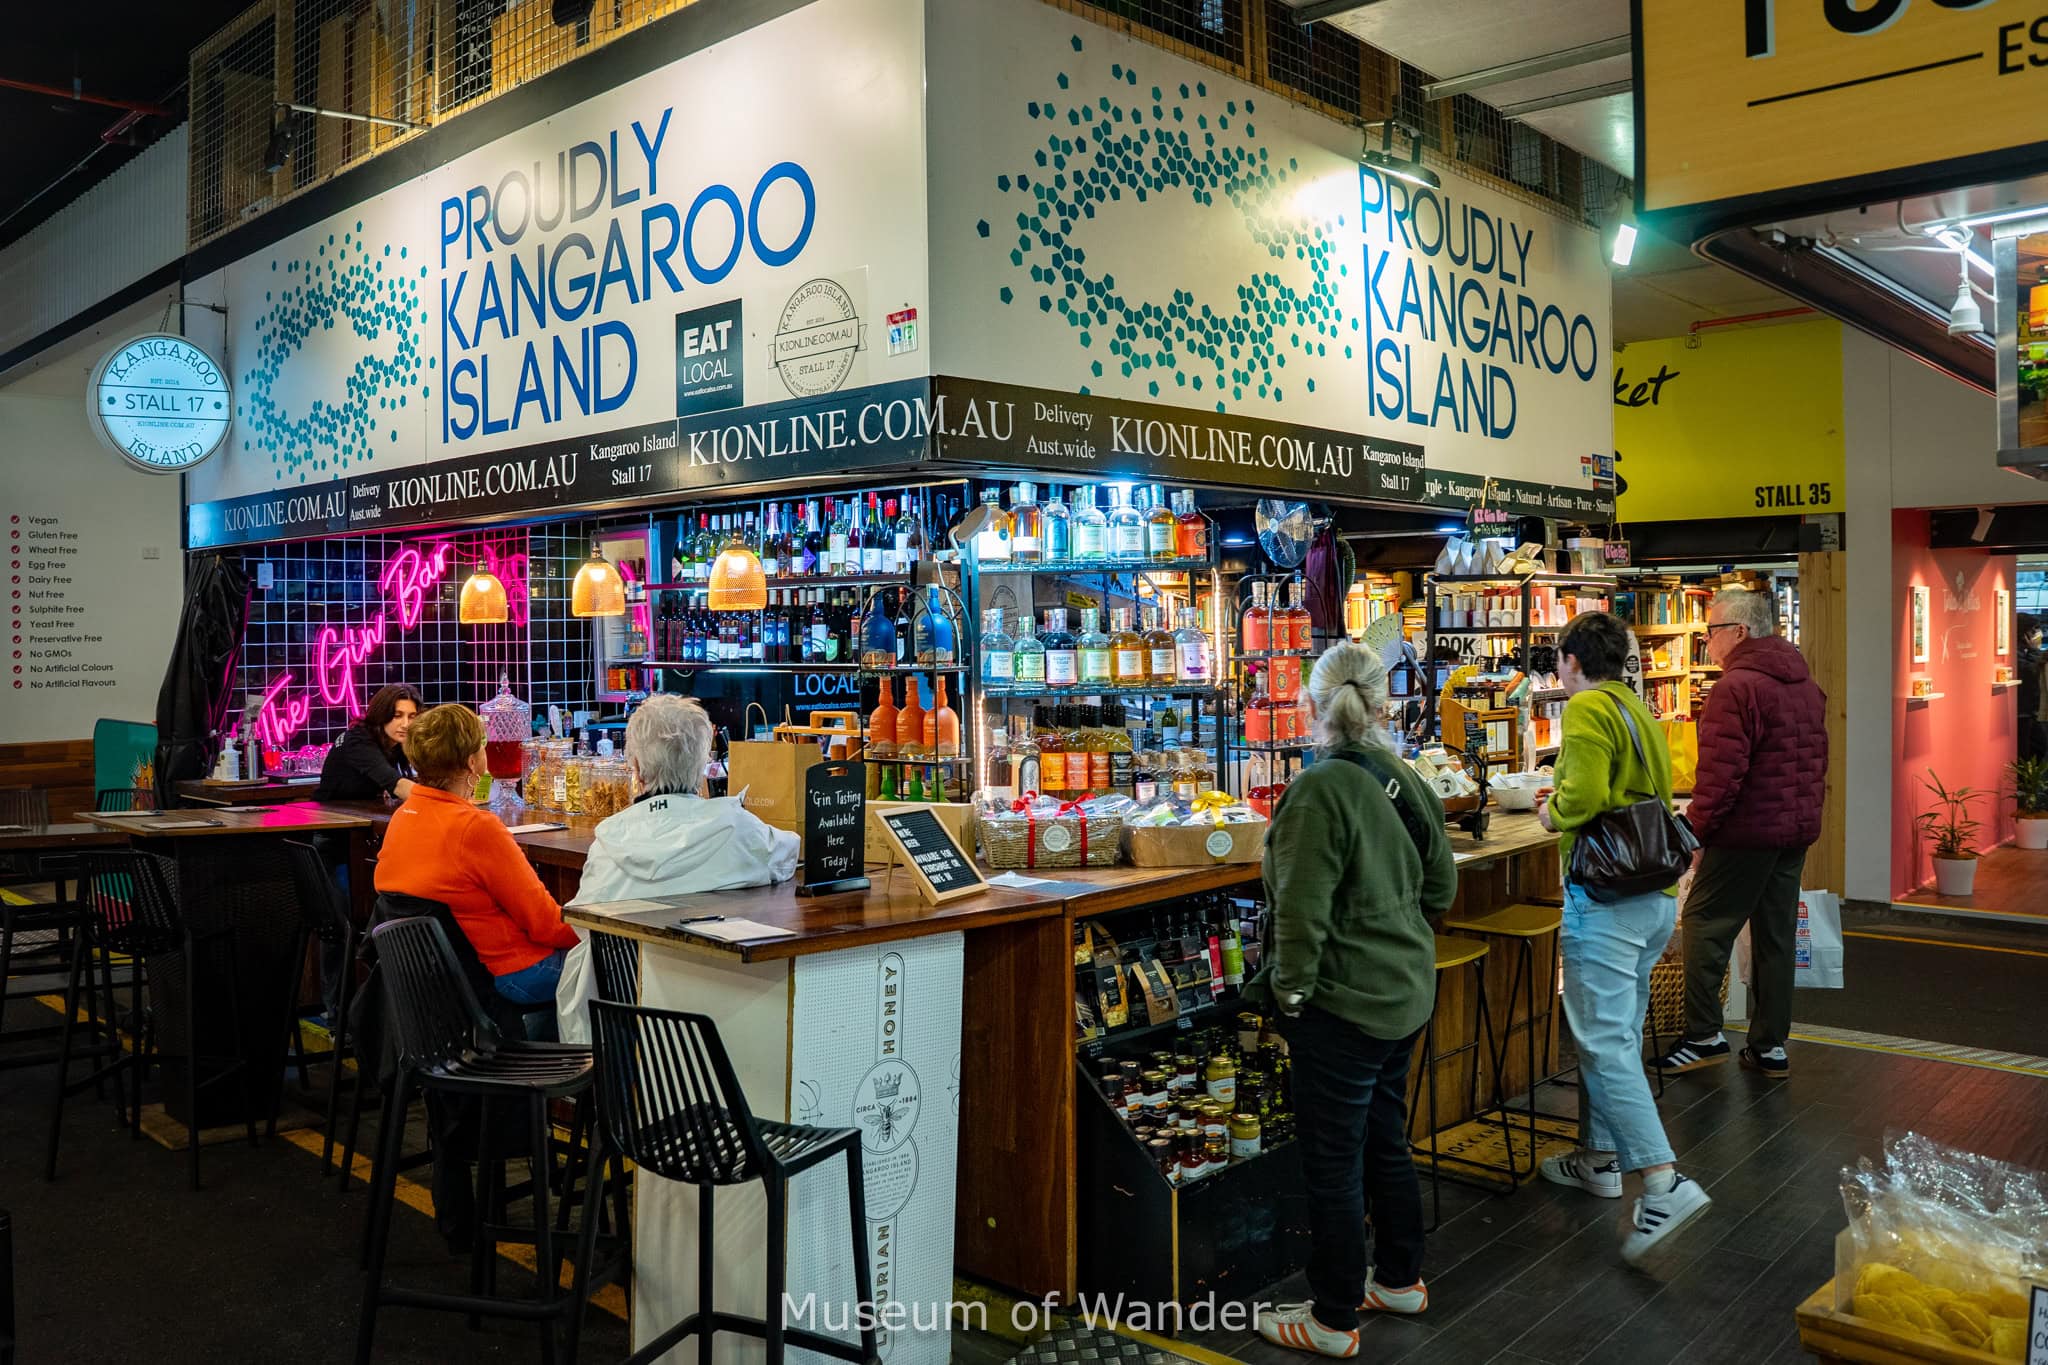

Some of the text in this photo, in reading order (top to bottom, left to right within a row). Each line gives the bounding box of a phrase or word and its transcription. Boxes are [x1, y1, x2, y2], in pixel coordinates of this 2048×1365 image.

[441, 106, 674, 269] PROUDLY
[1359, 164, 1534, 288] PROUDLY
[441, 161, 816, 352] KANGAROO
[782, 284, 852, 331] KANGAROO ISLAND
[1361, 244, 1598, 383] KANGAROO
[683, 320, 733, 359] EAT
[108, 341, 218, 386] KANGAROO
[683, 357, 734, 386] LOCAL
[800, 359, 835, 376] STALL 17
[441, 320, 638, 444] ISLAND
[1368, 337, 1518, 440] ISLAND
[125, 393, 205, 412] STALL 17
[1034, 402, 1094, 432] Delivery
[688, 394, 1016, 468] KIONLINE.COM.AU
[127, 437, 203, 465] ISLAND
[590, 431, 677, 463] Kangaroo Island
[1026, 434, 1097, 460] Aust.wide
[1109, 415, 1354, 479] KIONLINE.COM.AU
[1362, 444, 1425, 471] Kangaroo Island
[387, 453, 577, 509] KIONLINE.COM.AU
[611, 463, 653, 486] Stall 17
[1381, 474, 1410, 491] Stall 17
[352, 482, 381, 500] Delivery
[1515, 489, 1543, 507] Natural
[1546, 493, 1573, 509] Artisan
[1576, 496, 1593, 512] Pure
[1755, 482, 1831, 508] STALL 35
[28, 515, 58, 525] Vegan
[223, 489, 347, 532] KIONLINE.COM.AU
[349, 503, 382, 522] Aust.wide
[28, 531, 78, 540] Gluten Free
[28, 546, 78, 554] Wheat Free
[28, 561, 66, 570] Egg Free
[28, 576, 72, 584] Dairy Free
[28, 590, 65, 599] Nut Free
[29, 605, 84, 614] Sulphite Free
[30, 620, 75, 628] Yeast Free
[29, 635, 82, 643] Preservative
[260, 543, 450, 747] The Gin Bar
[1437, 636, 1476, 656] OOK
[30, 649, 72, 658] No GMOs
[30, 663, 114, 673] No Artificial Colours
[30, 679, 116, 688] No Artificial Flavours
[794, 673, 861, 696] LOCAL
[649, 799, 669, 812] HH
[812, 789, 862, 812] Gin Tasting
[818, 812, 856, 830] Available
[826, 834, 845, 848] Here
[821, 847, 855, 877] Today!
[882, 966, 898, 1055] HONEY
[855, 1103, 876, 1114] CIRCA
[863, 1164, 890, 1175] NGAROO
